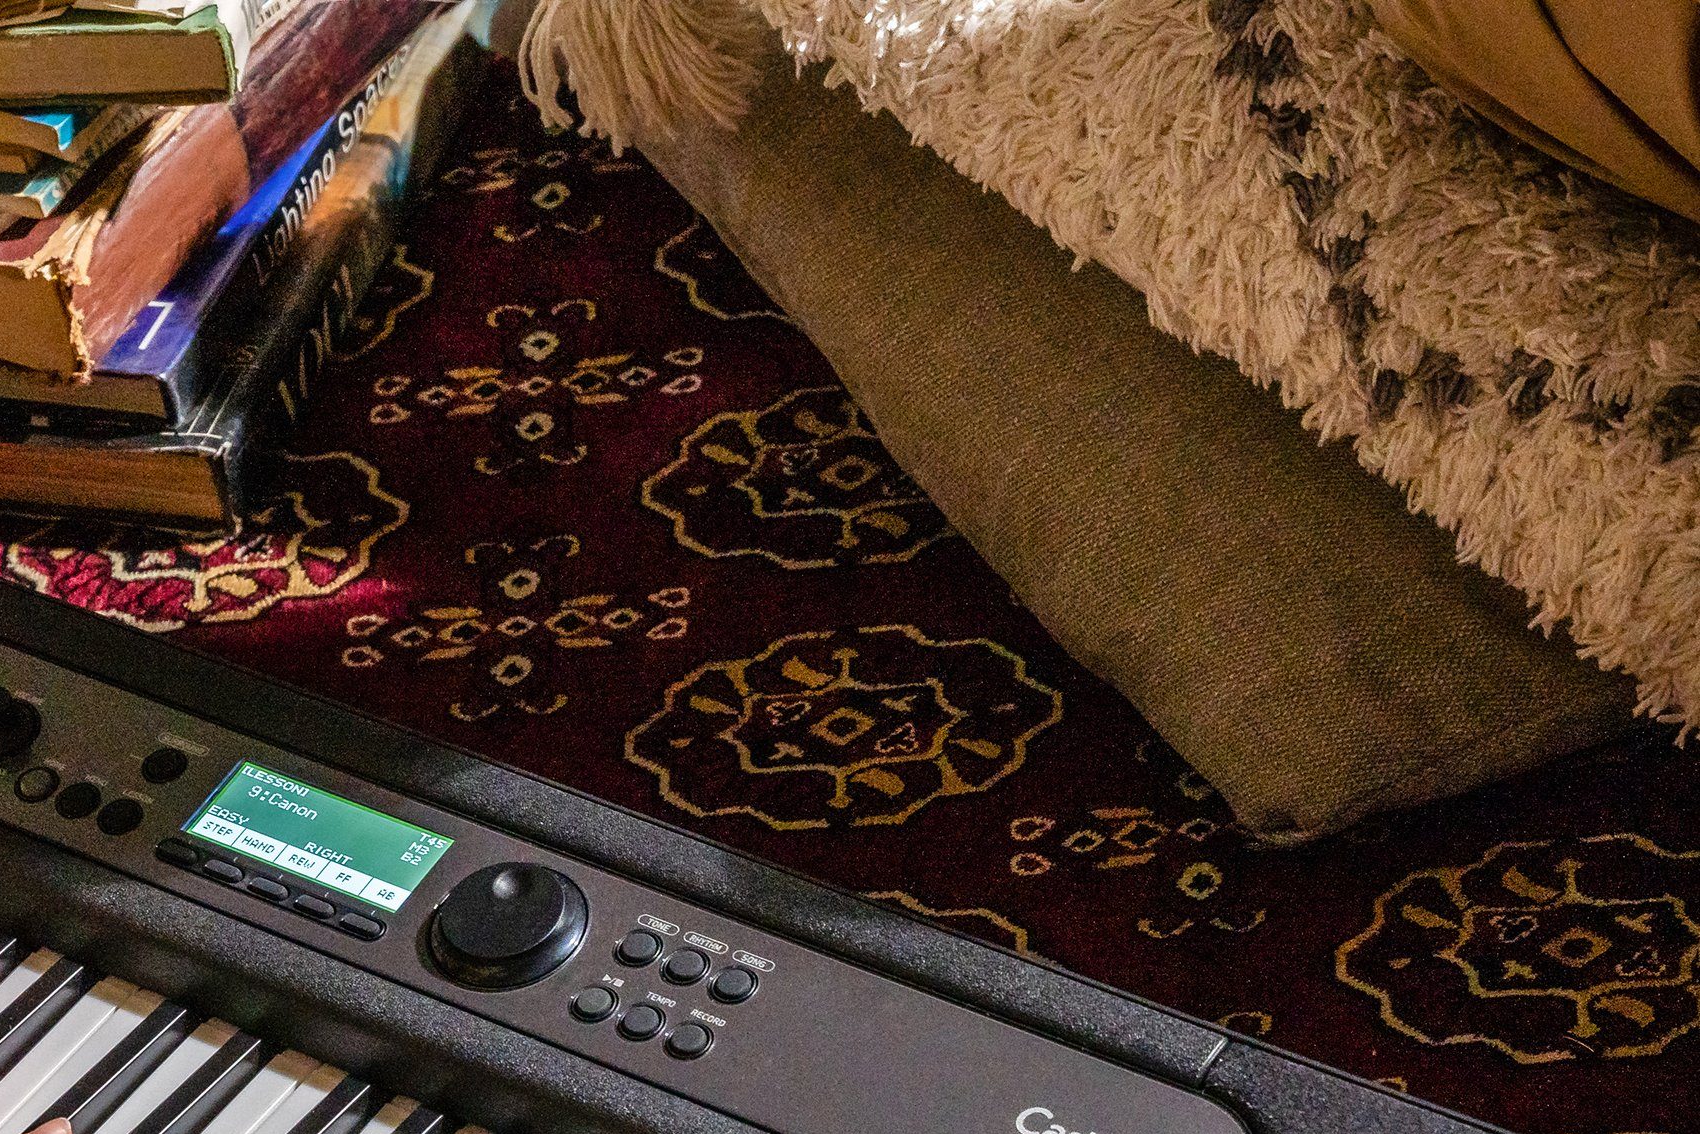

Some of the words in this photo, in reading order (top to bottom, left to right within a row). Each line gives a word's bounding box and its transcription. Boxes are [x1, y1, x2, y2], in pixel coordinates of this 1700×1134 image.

[207, 804, 250, 825] EASY
[202, 820, 234, 837] STEP
[241, 834, 276, 856] HAND
[288, 852, 316, 869] REW
[335, 871, 353, 884] FF
[408, 841, 431, 856] M3
[420, 832, 449, 850] T45
[303, 841, 353, 865] RIGHT
[400, 852, 423, 867] B2
[647, 916, 672, 933] TONE
[688, 933, 724, 953] RHYTHM
[739, 953, 767, 969] SONG
[646, 991, 677, 1008] TEMPO
[690, 1008, 727, 1028] RECORD
